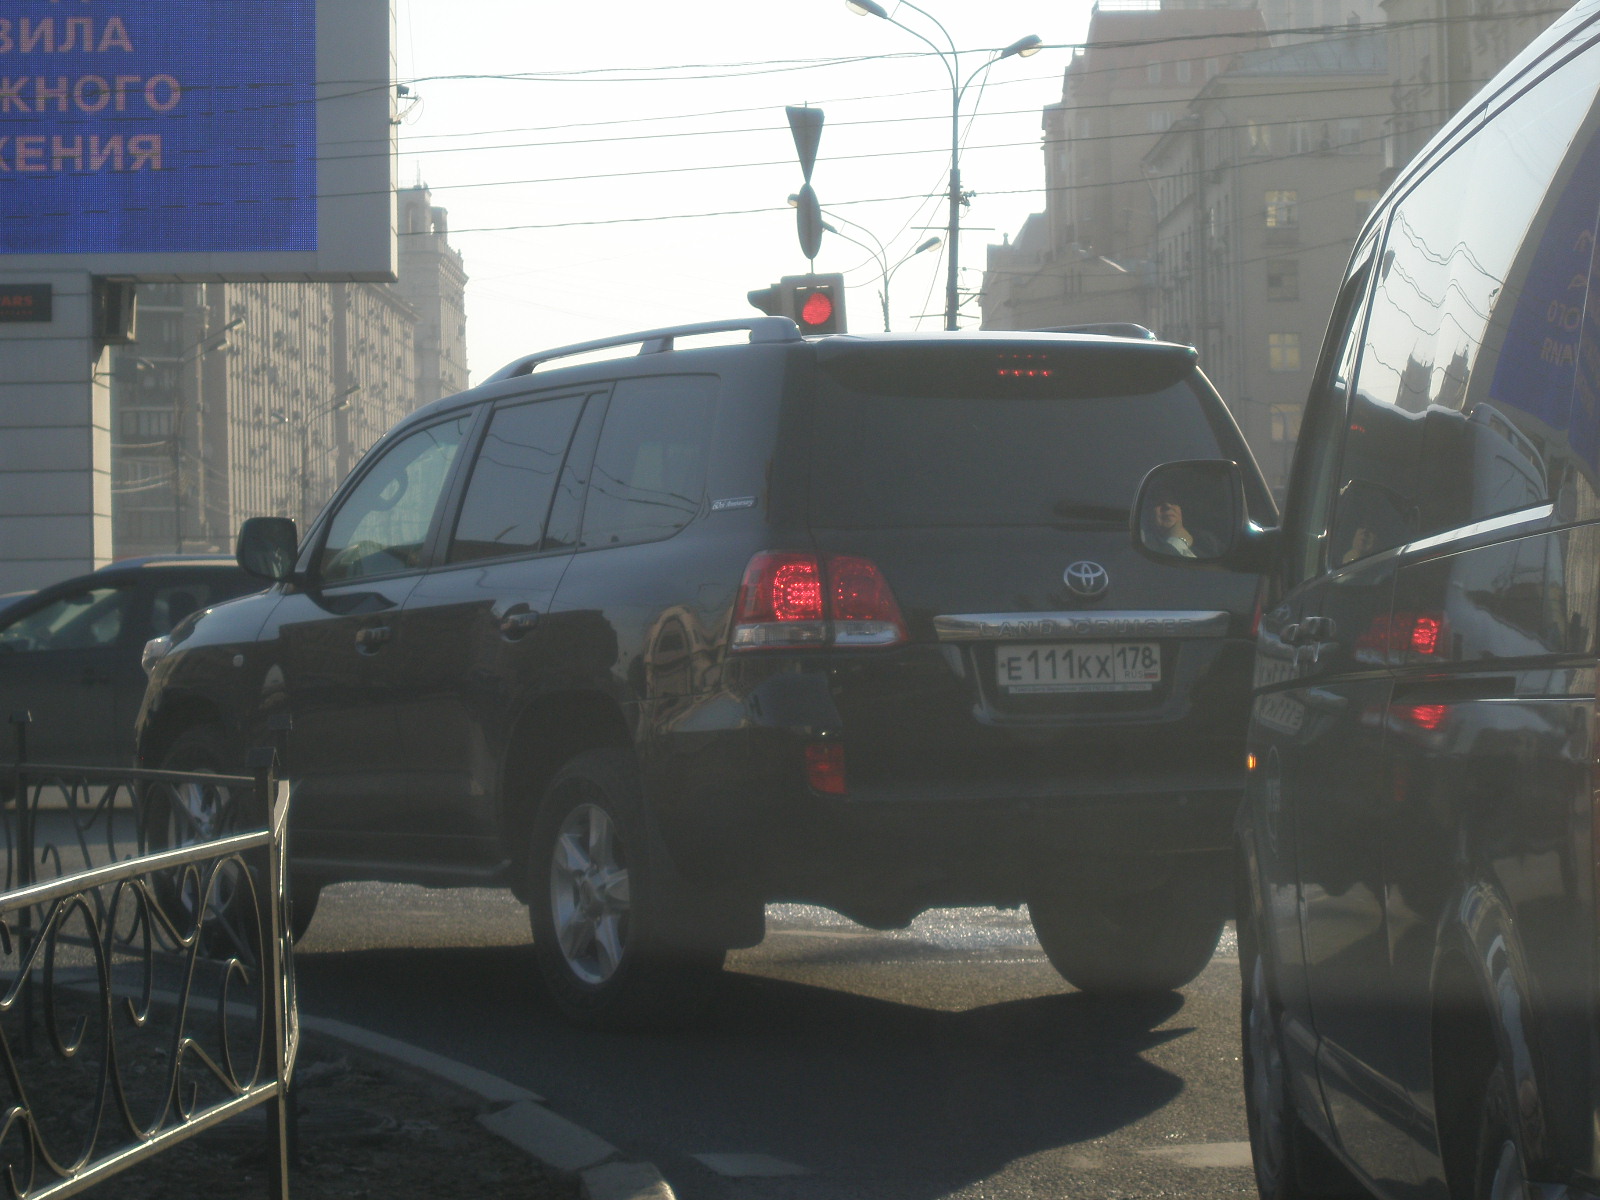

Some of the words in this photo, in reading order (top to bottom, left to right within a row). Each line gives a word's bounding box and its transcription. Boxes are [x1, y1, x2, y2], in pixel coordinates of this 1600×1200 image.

[0, 134, 161, 172] ЕНИЯ
[978, 620, 1054, 637] LAND
[1074, 618, 1194, 635] CRUISER
[1115, 646, 1152, 670] 178
[1125, 670, 1143, 679] RUS
